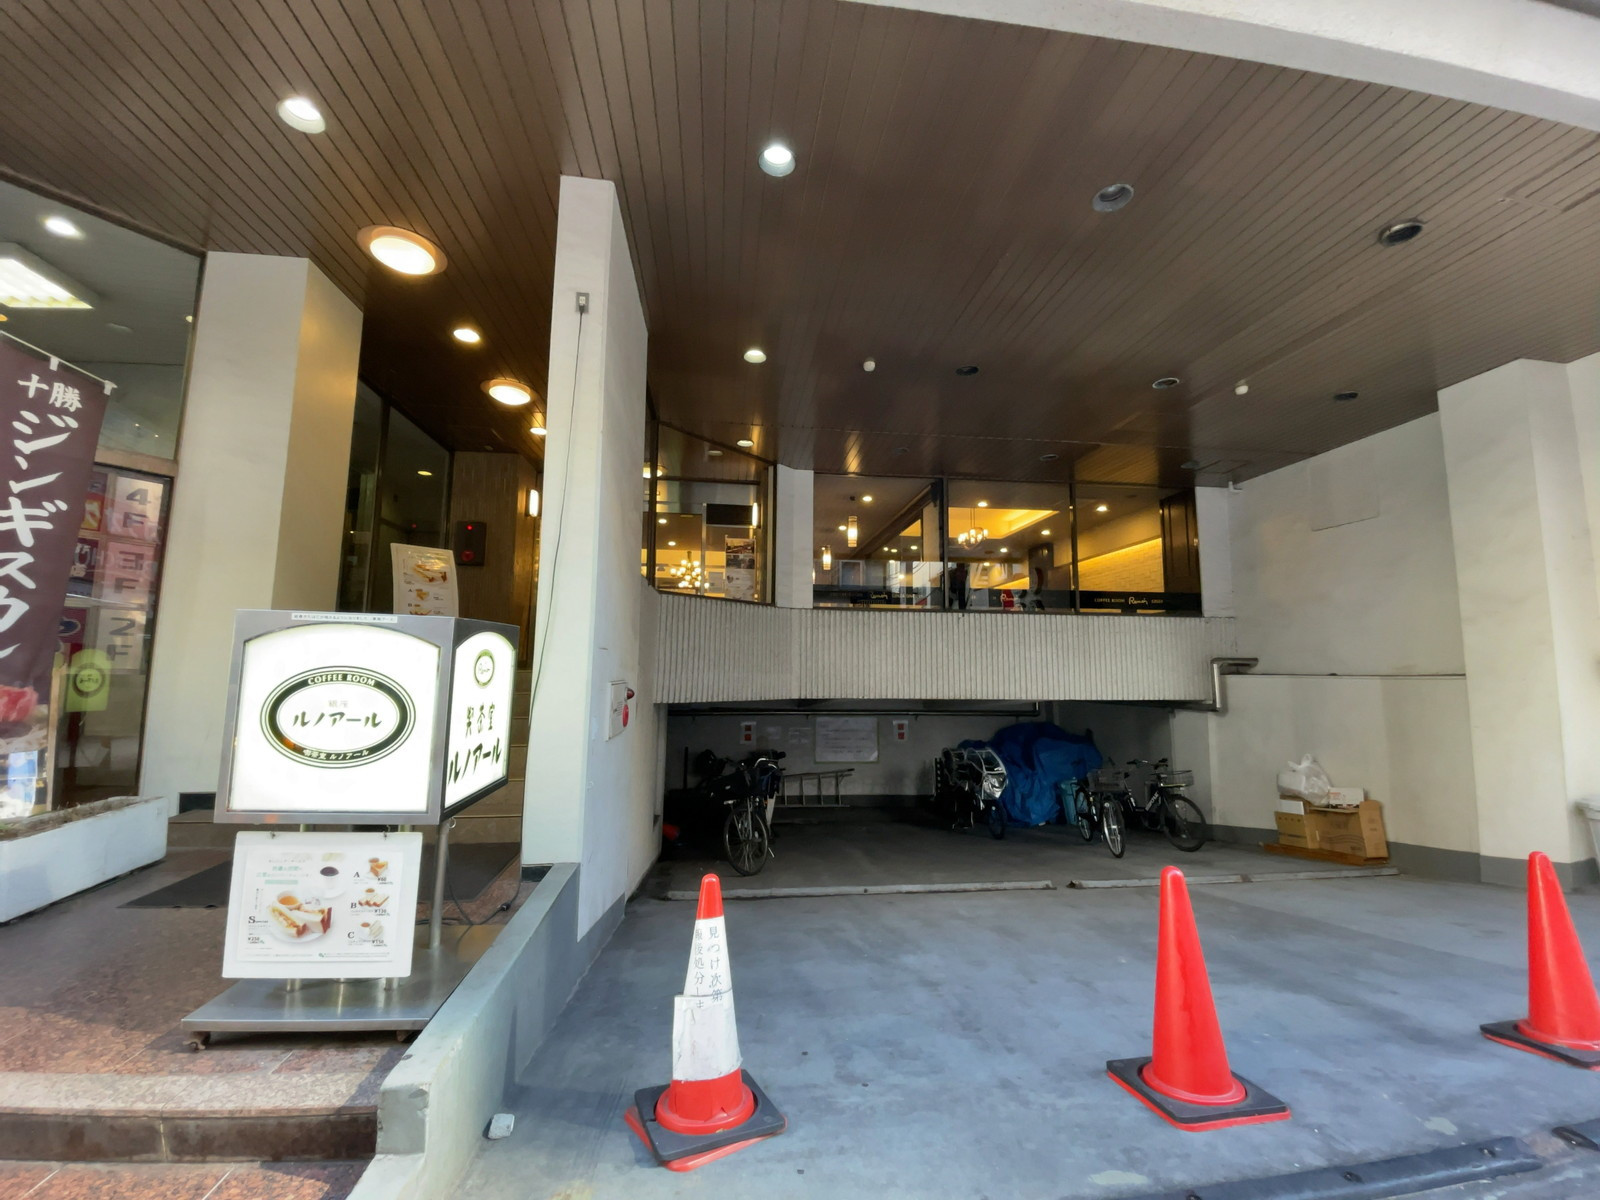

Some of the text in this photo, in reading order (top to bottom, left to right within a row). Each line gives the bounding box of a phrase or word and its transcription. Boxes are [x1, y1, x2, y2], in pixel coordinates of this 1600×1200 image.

[17, 373, 83, 412] 十勝
[0, 410, 79, 659] ジンギスカ
[307, 673, 376, 686] COFFEE ROOM
[292, 711, 382, 728] ルノアール
[329, 750, 369, 760] ルノアール
[447, 737, 502, 785] ルノアール
[347, 931, 355, 939] C
